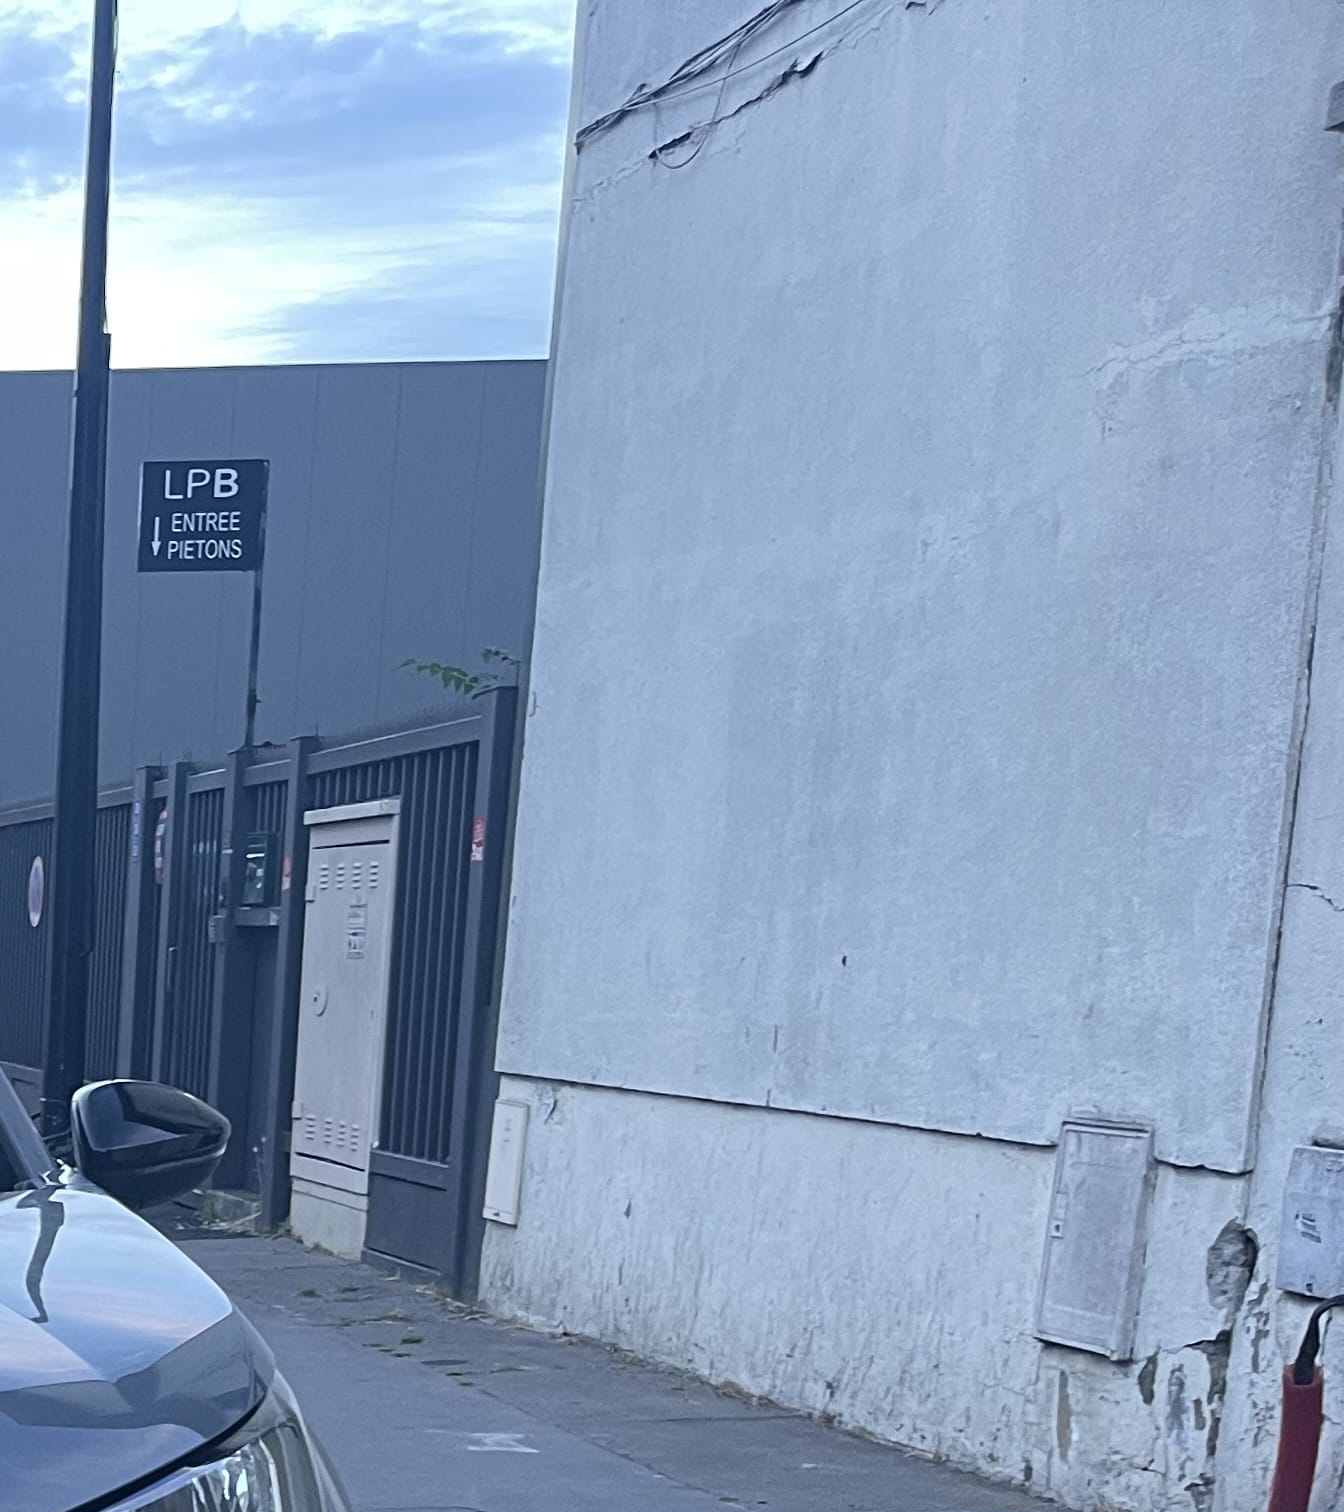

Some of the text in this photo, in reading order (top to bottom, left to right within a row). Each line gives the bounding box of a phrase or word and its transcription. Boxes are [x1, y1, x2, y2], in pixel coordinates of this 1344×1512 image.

[164, 467, 240, 500] LPB
[171, 511, 241, 533] ENTREE
[167, 539, 243, 560] PIETONS
